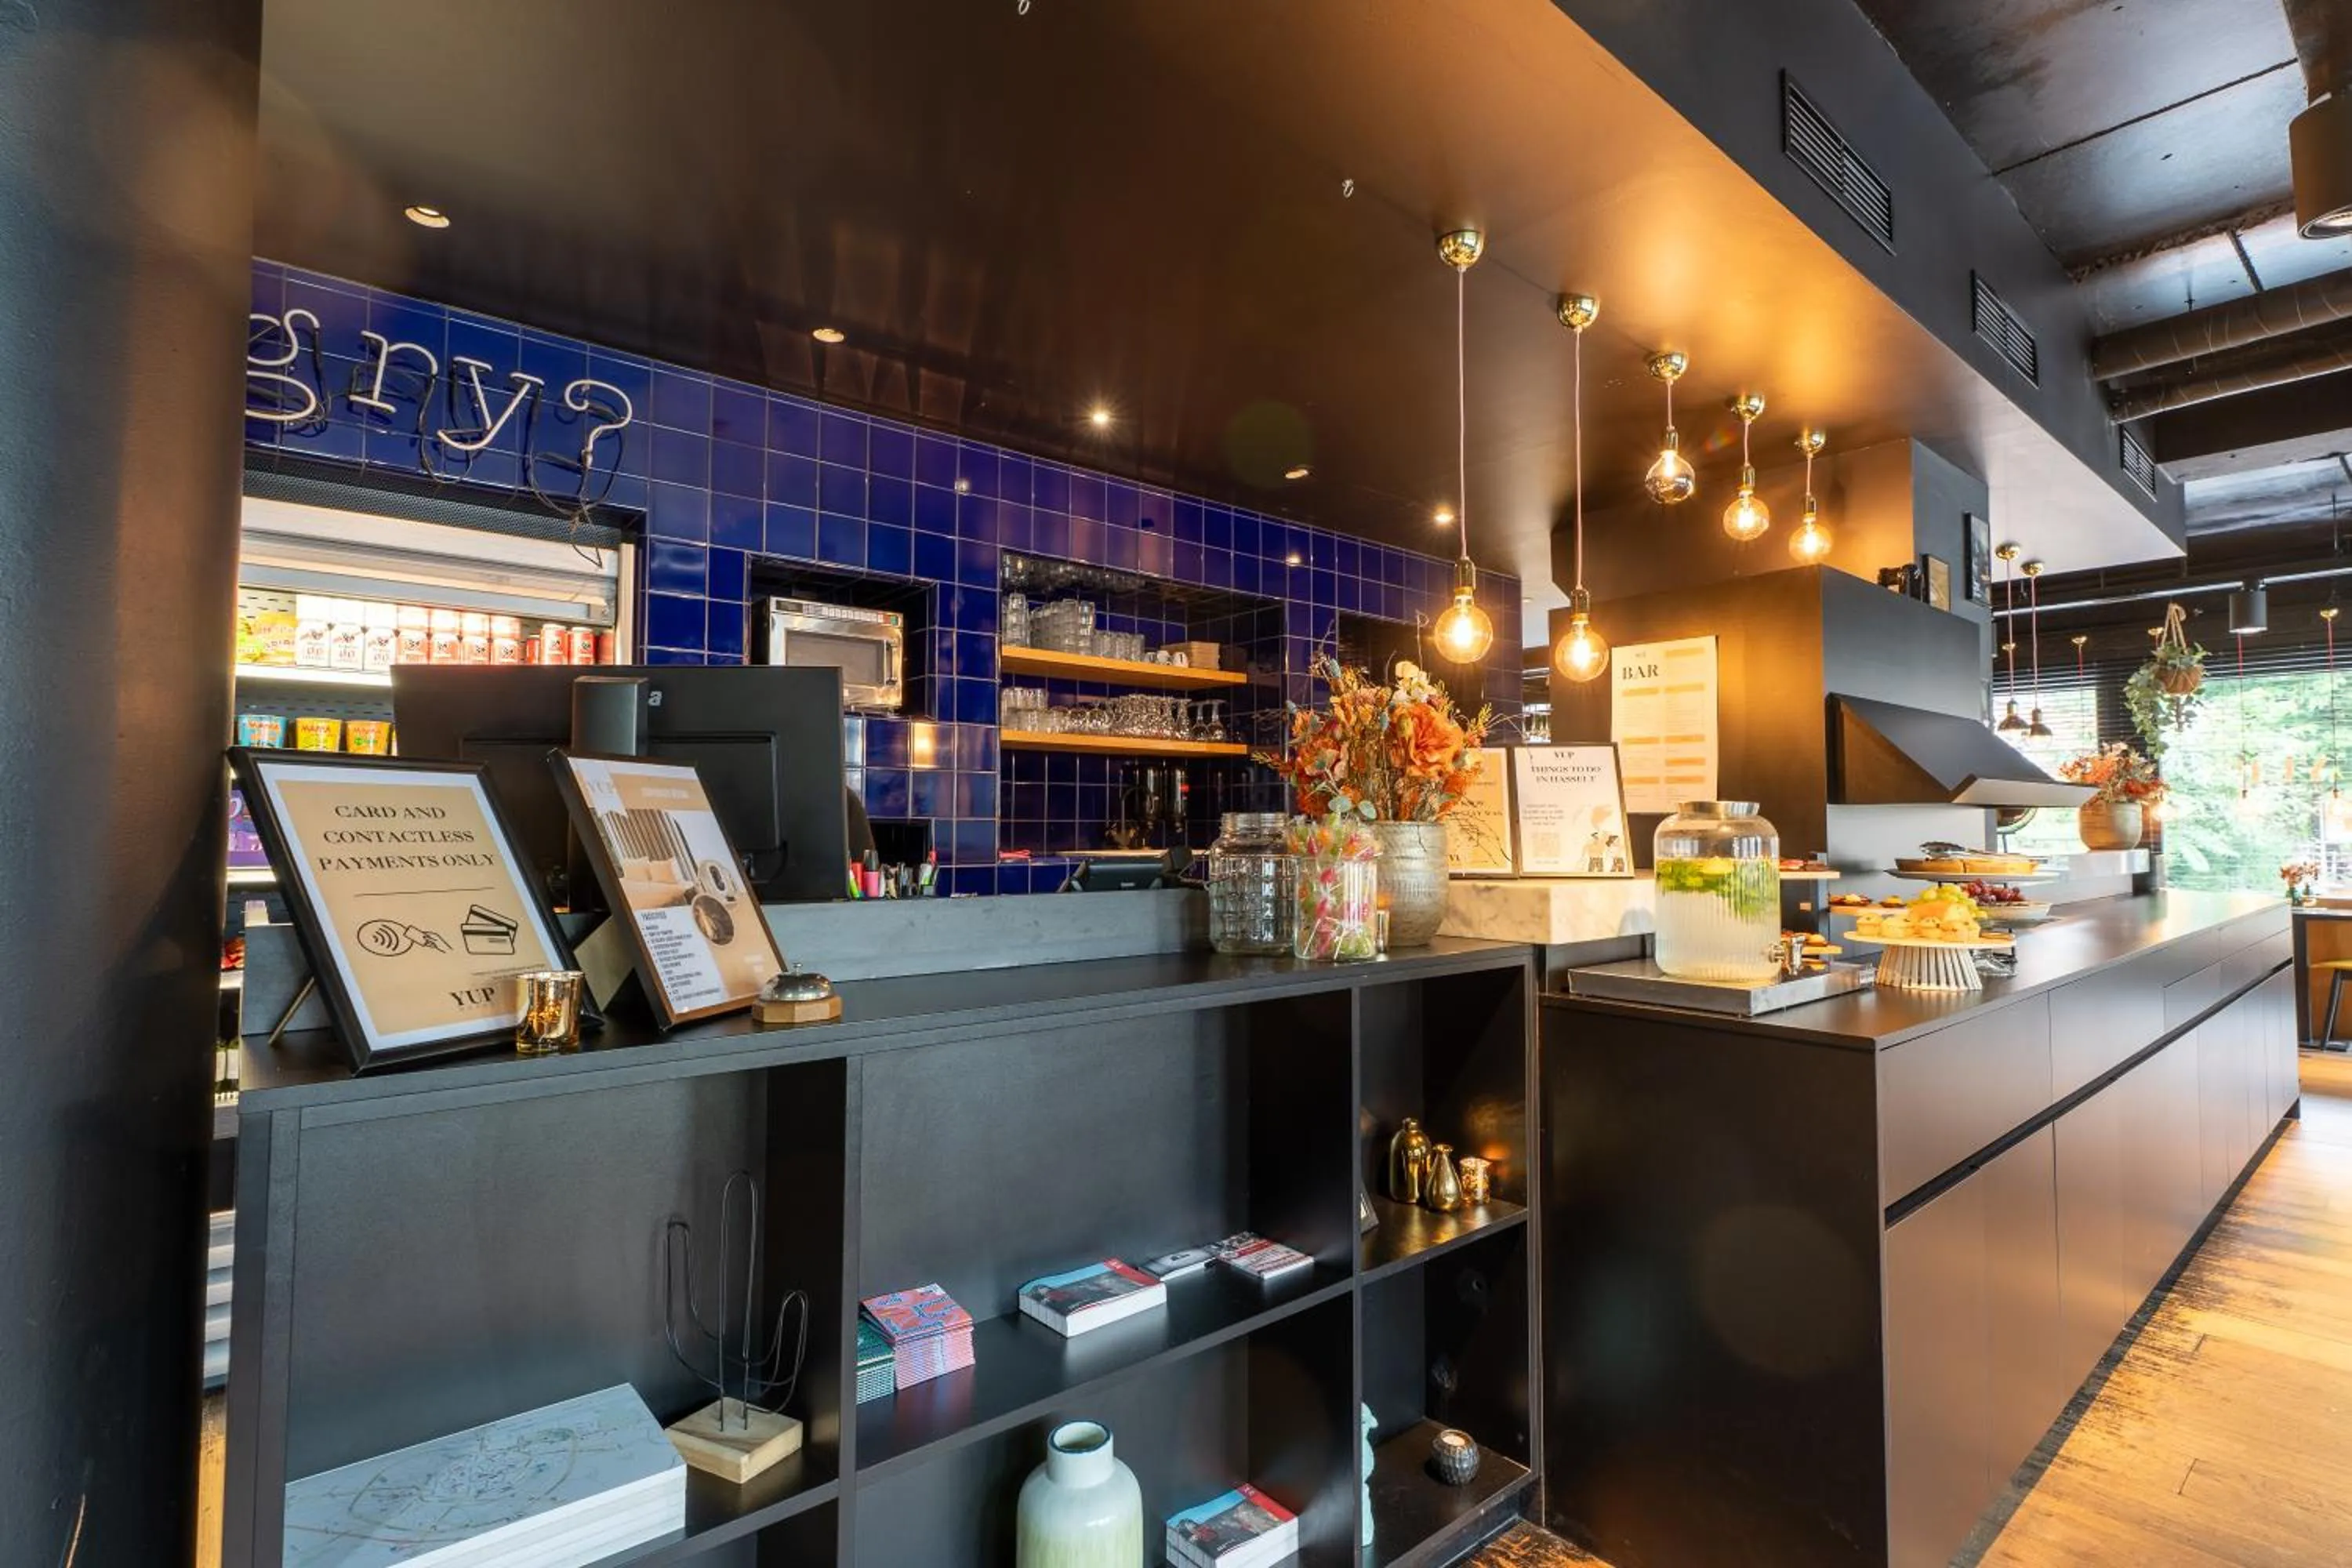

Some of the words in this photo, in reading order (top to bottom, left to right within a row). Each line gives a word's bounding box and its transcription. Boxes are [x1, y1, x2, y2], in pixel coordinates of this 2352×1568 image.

[1622, 664, 1658, 680] BAR
[335, 805, 397, 818] CARD
[403, 807, 446, 819] AND
[323, 829, 474, 844] CONTACTLESS
[318, 855, 439, 870] PAYMENTS
[443, 854, 495, 866] ONLY
[450, 988, 495, 1006] YUP
